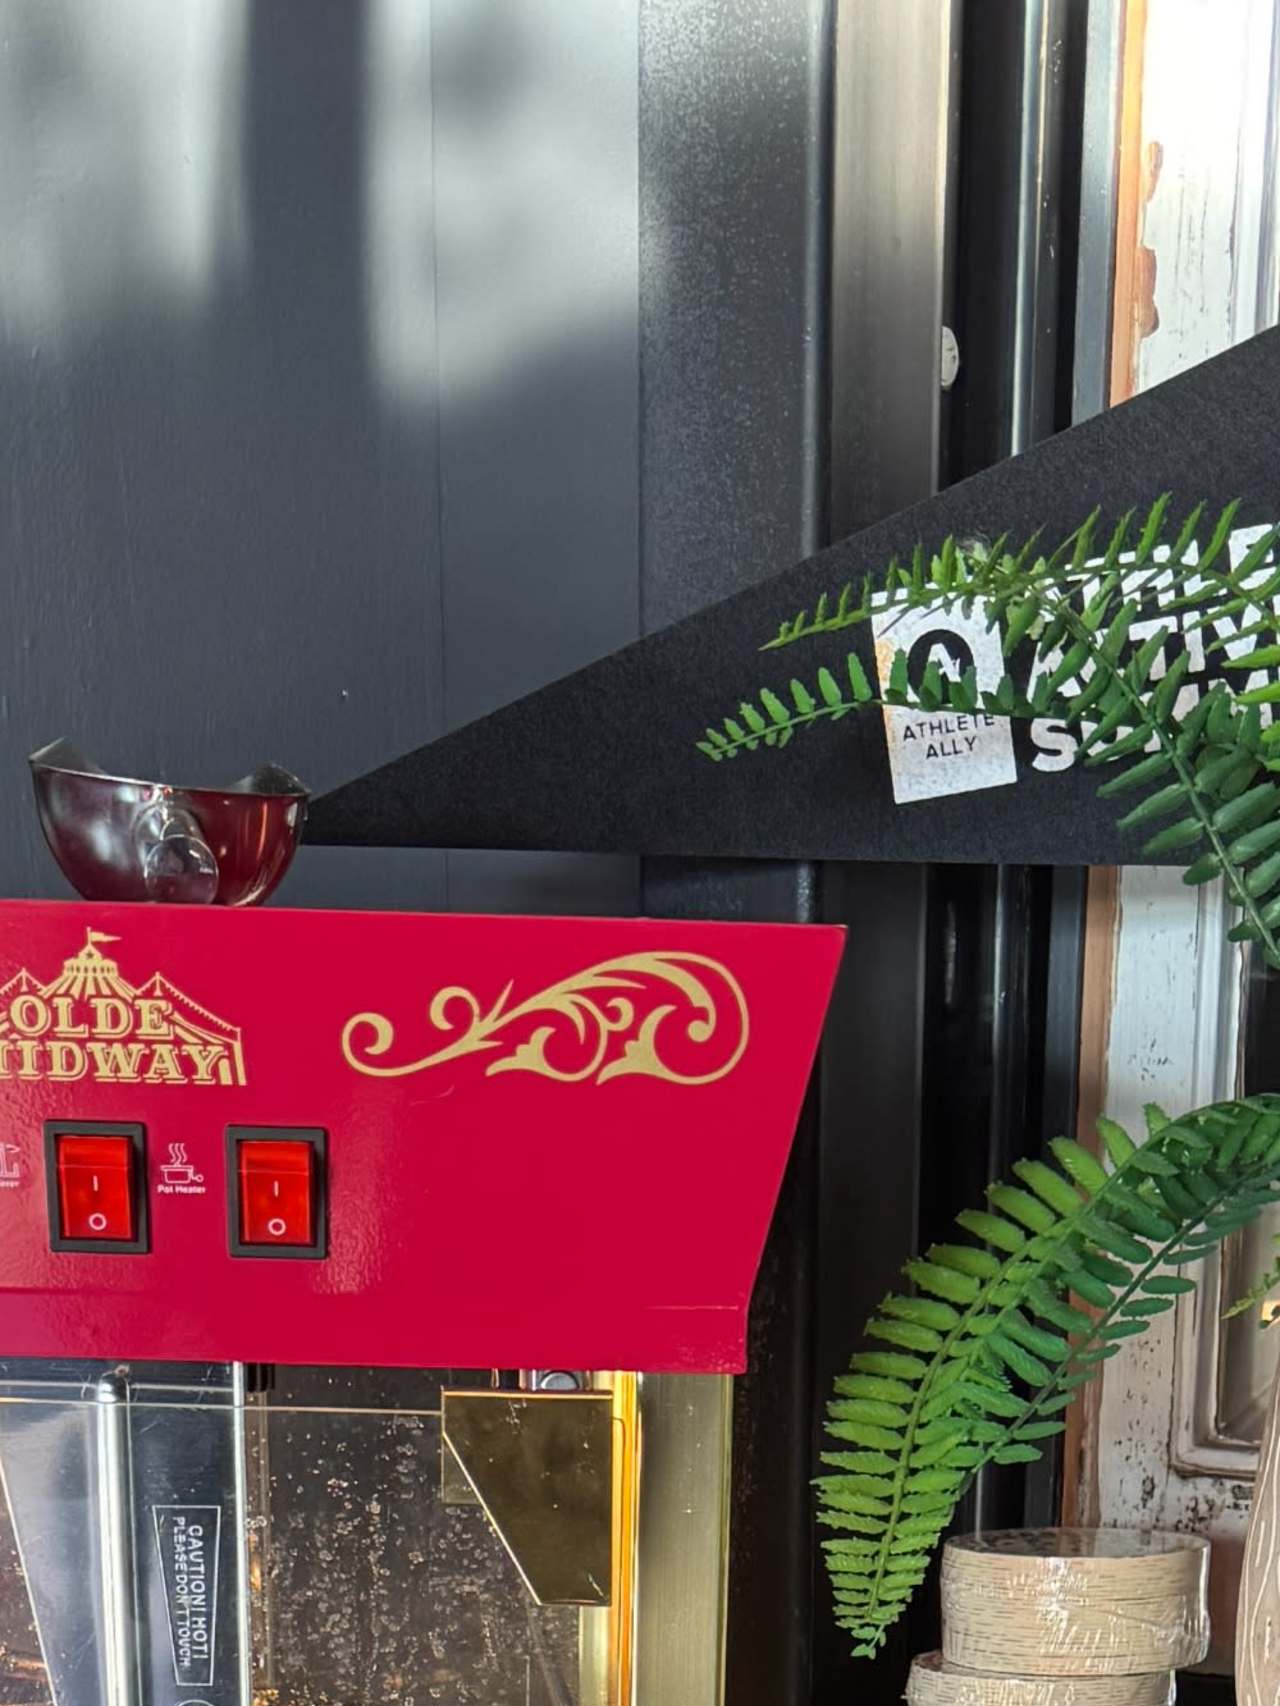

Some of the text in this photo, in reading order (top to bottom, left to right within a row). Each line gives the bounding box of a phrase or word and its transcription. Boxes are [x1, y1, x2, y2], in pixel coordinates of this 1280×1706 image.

[925, 736, 979, 760] ALLY
[10, 995, 174, 1039] OLDE
[173, 1516, 188, 1571] PLEASE
[177, 1620, 192, 1667] TOUCH
